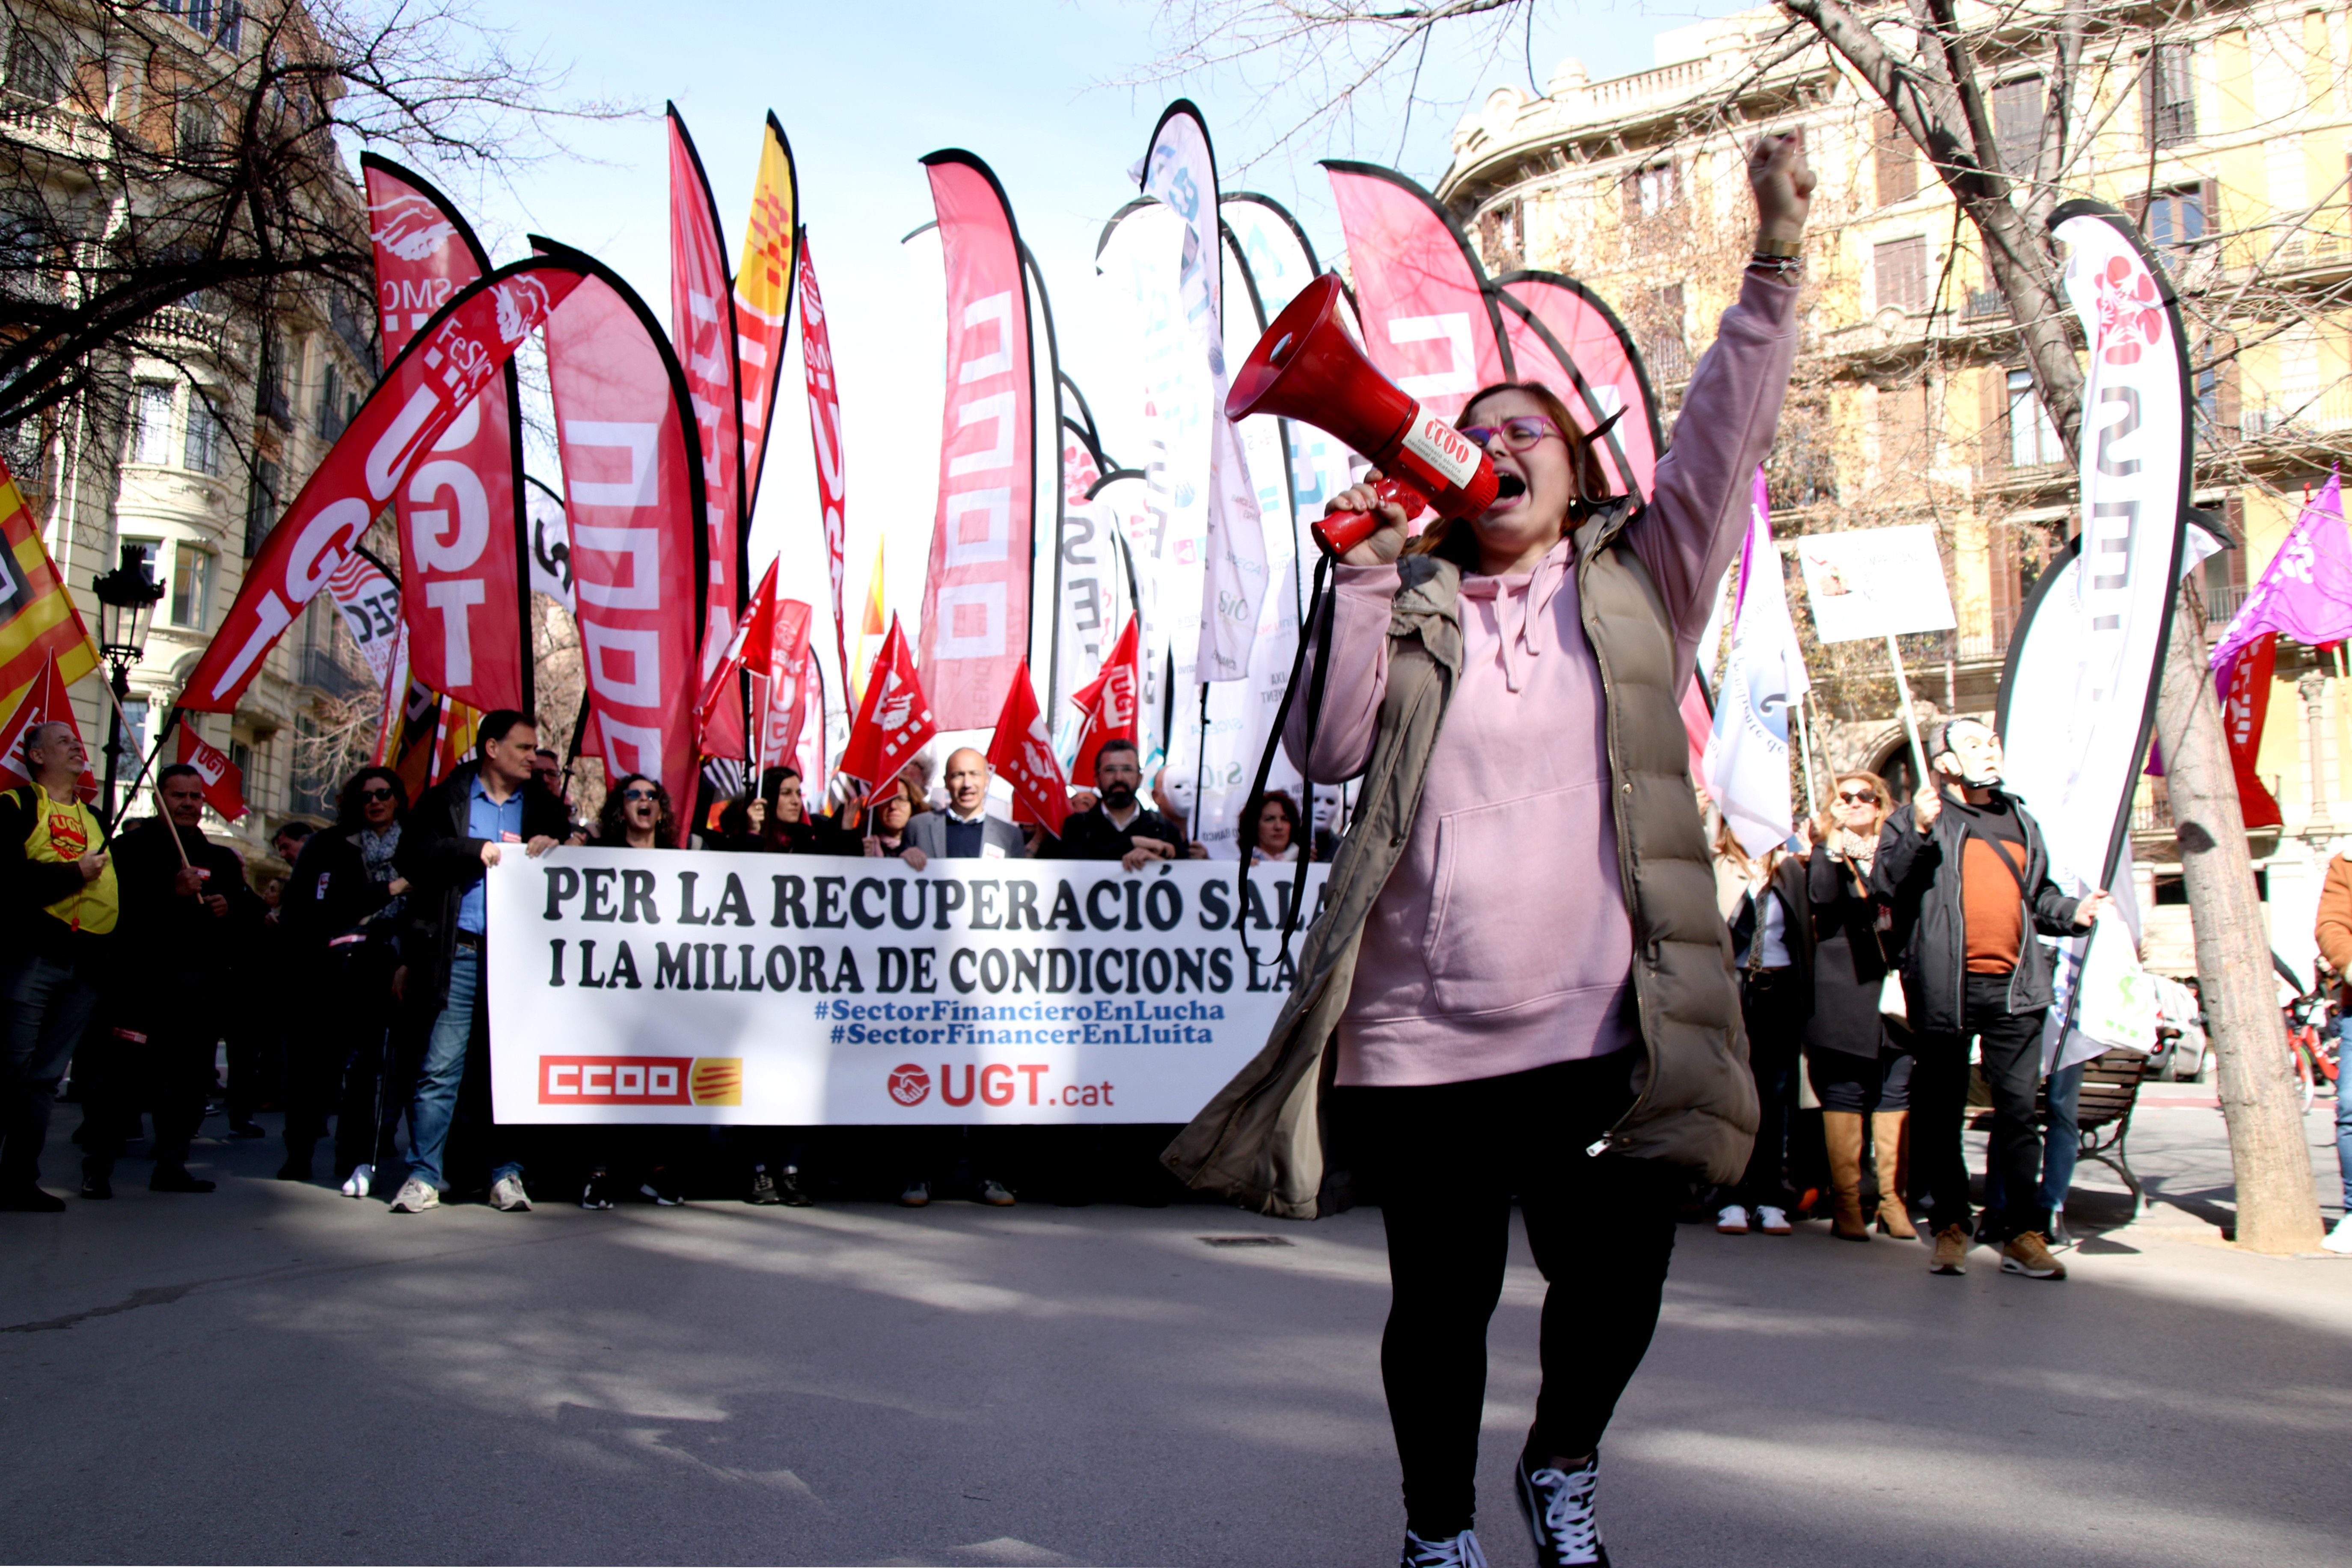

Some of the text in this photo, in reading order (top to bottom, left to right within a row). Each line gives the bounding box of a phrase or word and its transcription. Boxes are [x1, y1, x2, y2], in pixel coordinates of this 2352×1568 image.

[1425, 420, 1469, 464] CCOO
[211, 383, 447, 701] UGT
[543, 867, 661, 924] PER
[677, 871, 756, 927] LA
[770, 864, 1184, 932] RECUPERACIÓ
[549, 938, 566, 986] I
[578, 940, 642, 989] LA
[653, 941, 865, 993] MILLORA
[876, 946, 938, 994] DE
[950, 947, 1233, 994] CONDICIONS
[814, 1000, 1226, 1022] #SectorFinancieroEnLucha
[830, 1023, 1214, 1045] #SectorFinancerEnLluita
[548, 1063, 1114, 1107] CCOO UGT.cat
